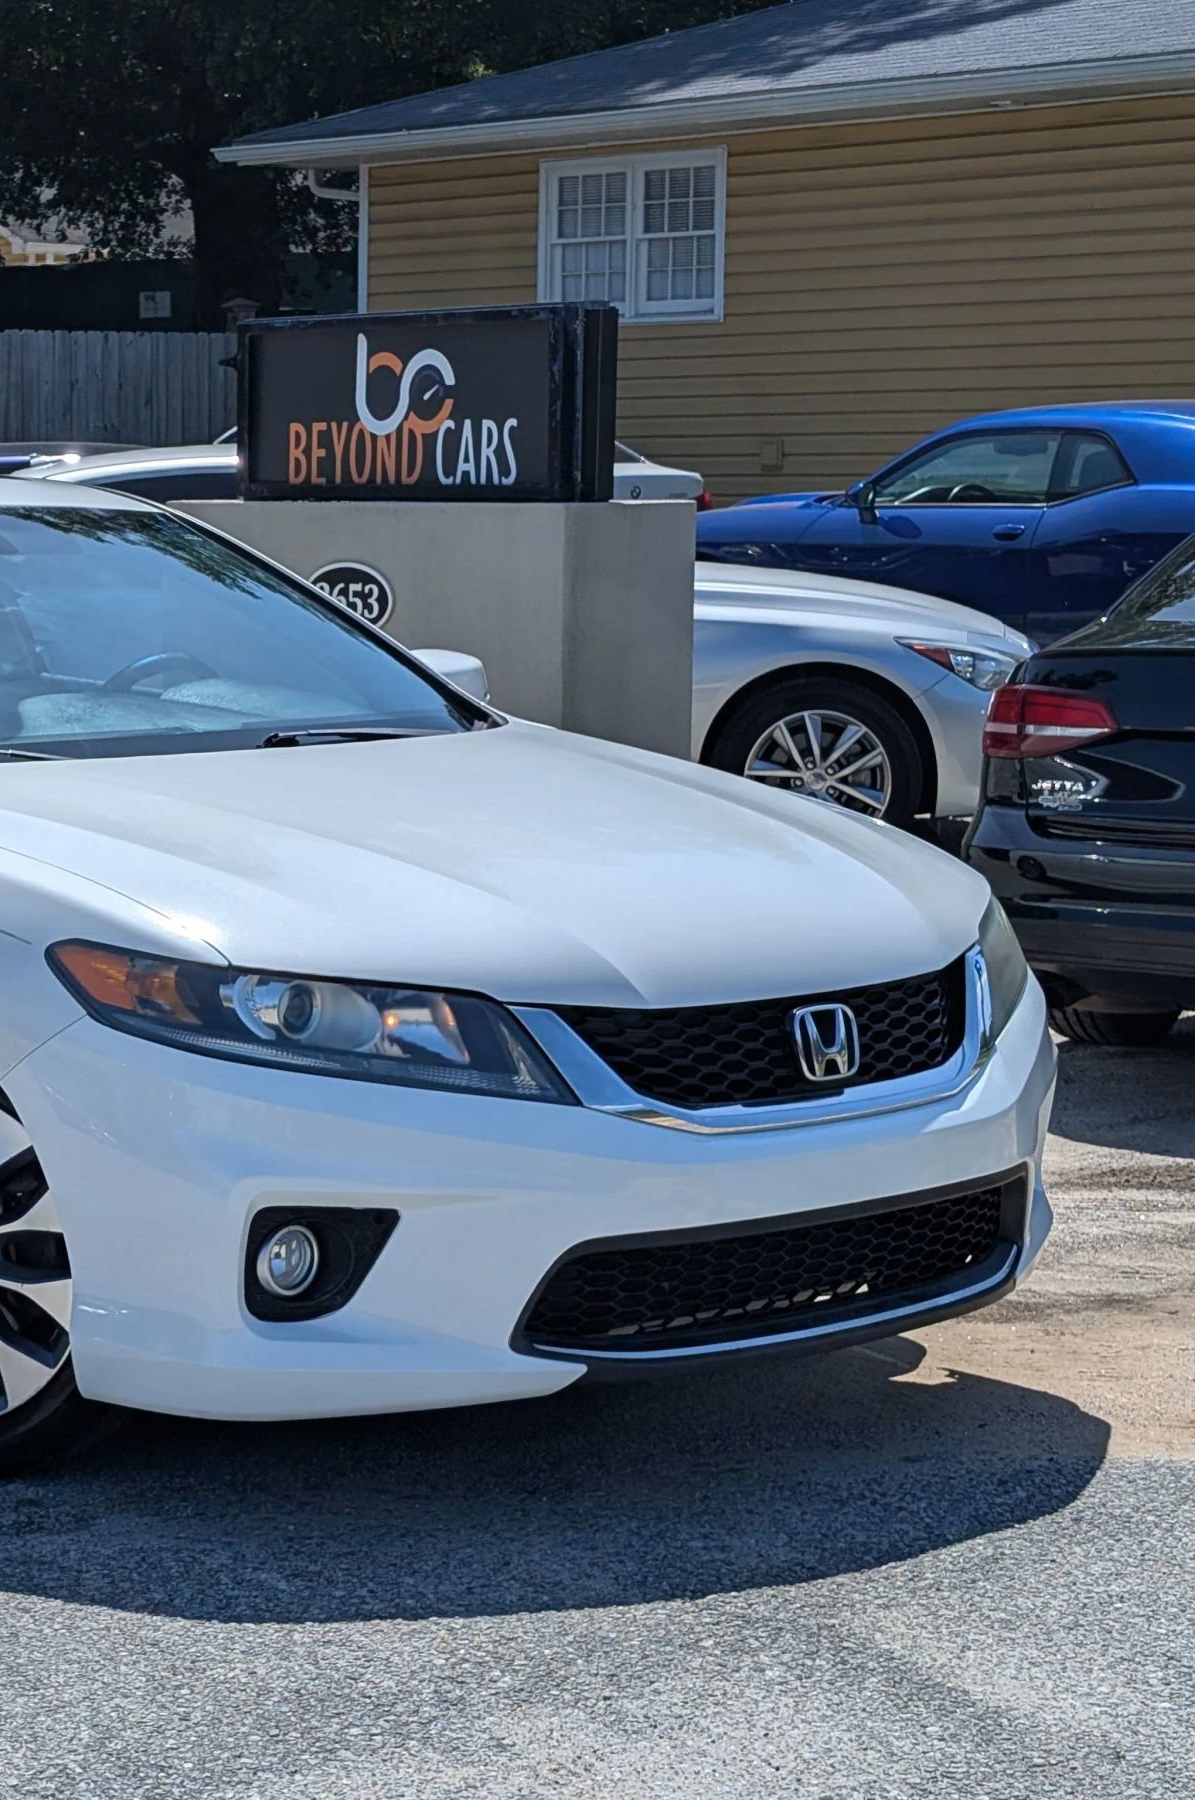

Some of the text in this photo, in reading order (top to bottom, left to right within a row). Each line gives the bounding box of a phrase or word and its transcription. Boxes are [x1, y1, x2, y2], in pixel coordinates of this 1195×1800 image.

[289, 418, 518, 486] BEYOND CARS
[1031, 779, 1084, 791] JETTA
